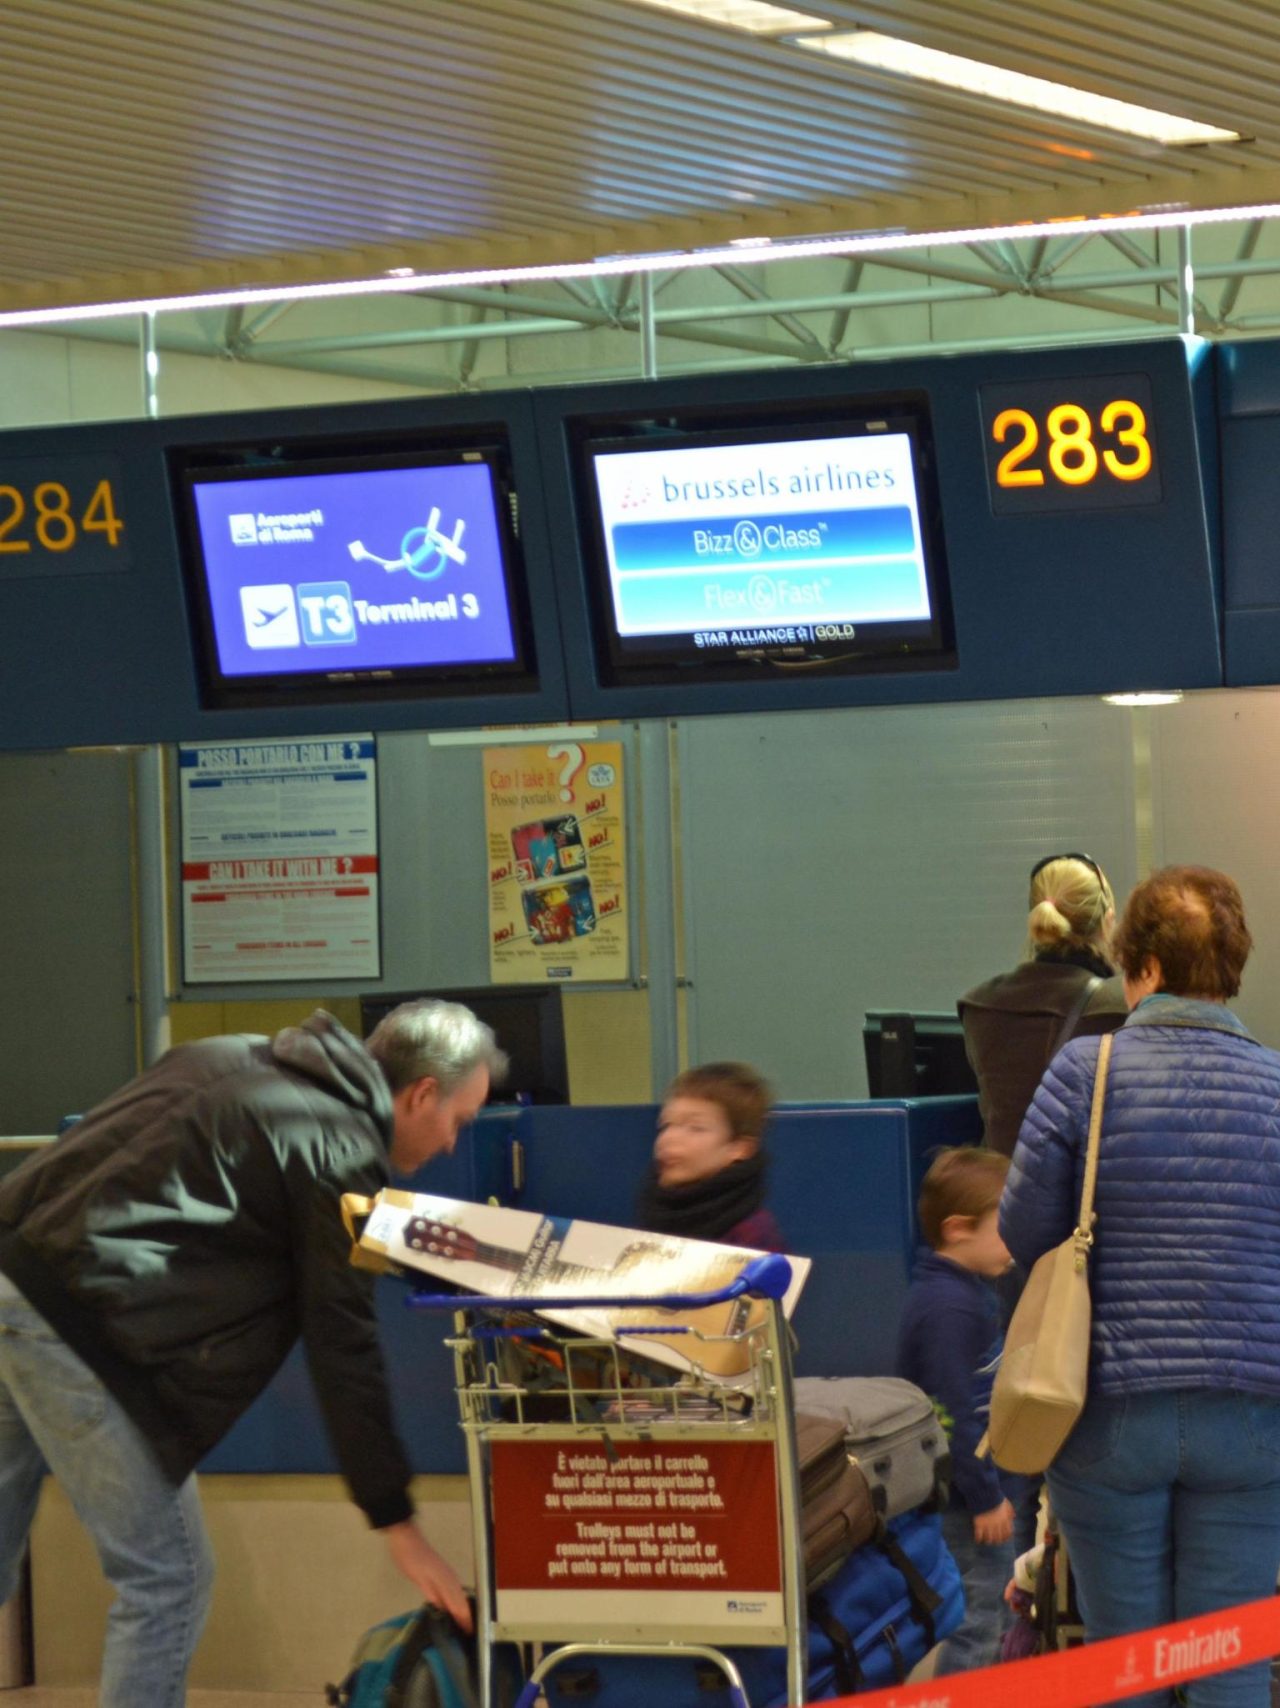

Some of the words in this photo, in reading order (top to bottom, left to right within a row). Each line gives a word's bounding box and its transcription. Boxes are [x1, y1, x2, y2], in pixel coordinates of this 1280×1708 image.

[992, 400, 1153, 488] 283
[663, 468, 780, 502] brussels
[789, 464, 895, 494] airlines
[0, 480, 124, 553] 284
[257, 509, 323, 528] Aeroporti
[258, 529, 271, 543] di
[273, 528, 314, 543] Roma
[693, 529, 733, 556] Bizz
[704, 583, 746, 609] Flex
[301, 594, 352, 637] T3
[354, 594, 457, 625] Terminal
[461, 593, 480, 618] 3
[693, 630, 728, 648] STAR
[730, 627, 796, 646] ALLIANCE
[815, 624, 854, 641] GOLD
[198, 748, 236, 768] POSSO
[239, 745, 298, 767] PORTARLO
[301, 744, 324, 764] CON
[327, 743, 343, 762] ME
[490, 769, 511, 789] Can
[522, 769, 545, 788] take
[491, 792, 519, 807] Posso
[520, 792, 556, 809] portarlo
[210, 862, 233, 880] CAN
[243, 861, 270, 879] TAKE
[273, 860, 284, 877] IT
[286, 859, 318, 877] WITH
[321, 858, 338, 876] ME
[569, 1455, 608, 1471] vietato
[610, 1455, 651, 1474] portare
[654, 1454, 661, 1471] il
[665, 1455, 709, 1471] carrello
[553, 1473, 580, 1488] fuori
[582, 1472, 630, 1489] dall'area
[633, 1473, 704, 1491] aeroportuale
[707, 1477, 715, 1488] e
[545, 1493, 560, 1507] su
[563, 1492, 612, 1510] qualsiasi
[615, 1494, 652, 1507] mezzo
[655, 1491, 666, 1507] di
[669, 1492, 725, 1510] trasporto.
[576, 1521, 621, 1540] Trolleys
[624, 1523, 654, 1538] must
[658, 1523, 678, 1538] not
[680, 1522, 695, 1538] be
[556, 1541, 605, 1556] removed
[609, 1541, 636, 1556] from
[639, 1541, 659, 1556] the
[662, 1541, 702, 1559] airport
[705, 1543, 717, 1556] or
[548, 1561, 568, 1577] put
[571, 1560, 597, 1575] onto
[600, 1561, 620, 1577] any
[624, 1560, 652, 1575] form
[655, 1560, 667, 1575] of
[670, 1559, 727, 1578] transport.
[1154, 1625, 1242, 1679] Emirates
